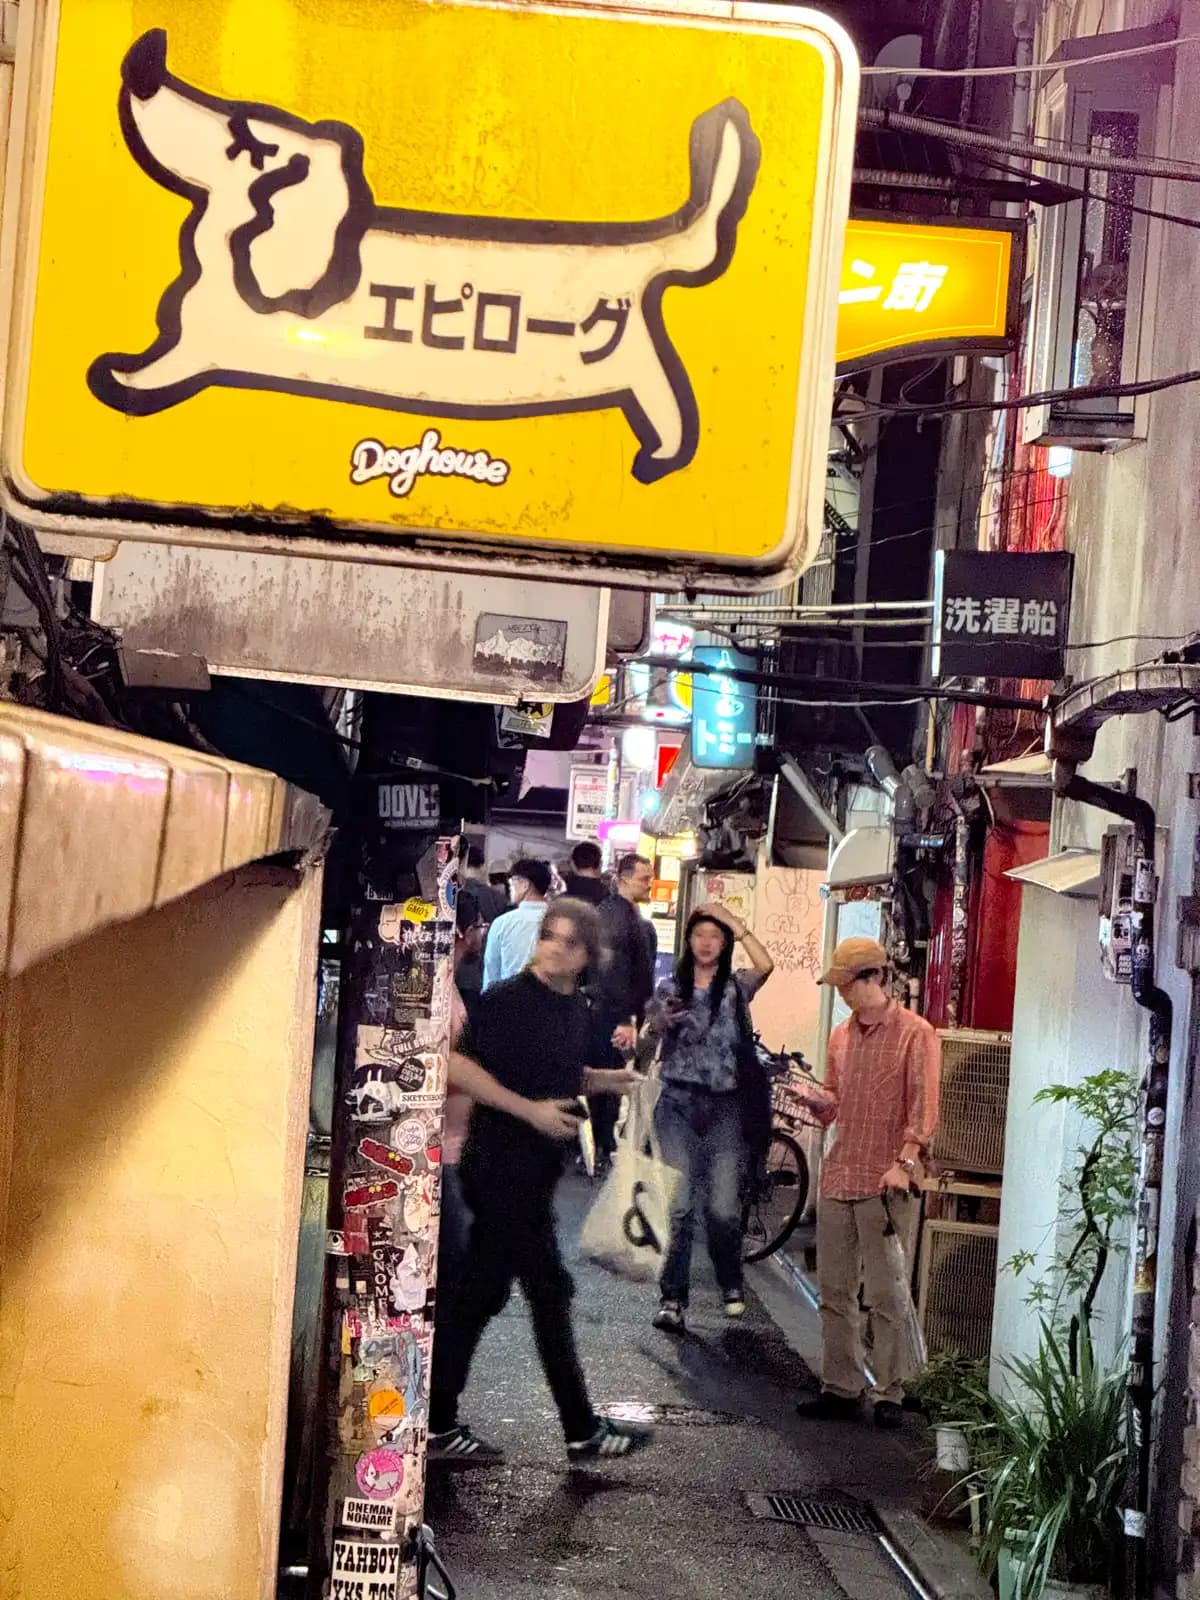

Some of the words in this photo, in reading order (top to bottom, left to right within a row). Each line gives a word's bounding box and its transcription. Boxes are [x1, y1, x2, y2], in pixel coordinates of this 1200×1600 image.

[364, 282, 632, 365] エピローグ
[350, 428, 510, 498] Doghouse
[945, 597, 1057, 636] 洗濯船
[346, 1512, 392, 1526] NONAME
[348, 1501, 393, 1516] ONEMAN
[335, 1544, 398, 1574] YAHBOY
